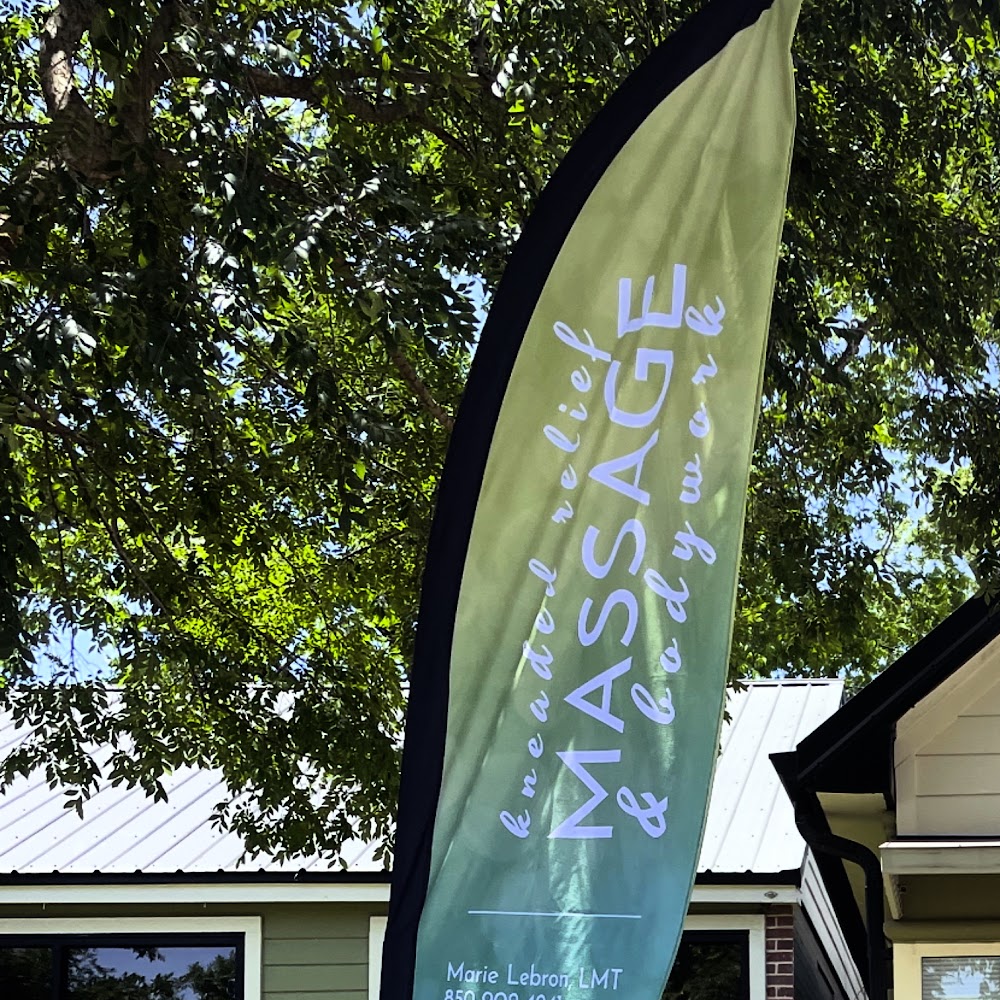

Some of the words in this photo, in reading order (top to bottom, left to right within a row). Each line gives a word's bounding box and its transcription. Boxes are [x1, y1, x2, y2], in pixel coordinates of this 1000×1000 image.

[499, 558, 558, 839] kneaded
[543, 320, 612, 525] relief
[547, 263, 688, 839] MASSAGE
[630, 295, 727, 725] bodywork
[446, 961, 499, 984] Marie
[507, 963, 573, 991] Lebron,
[578, 967, 623, 991] LMT
[616, 786, 669, 839] &
